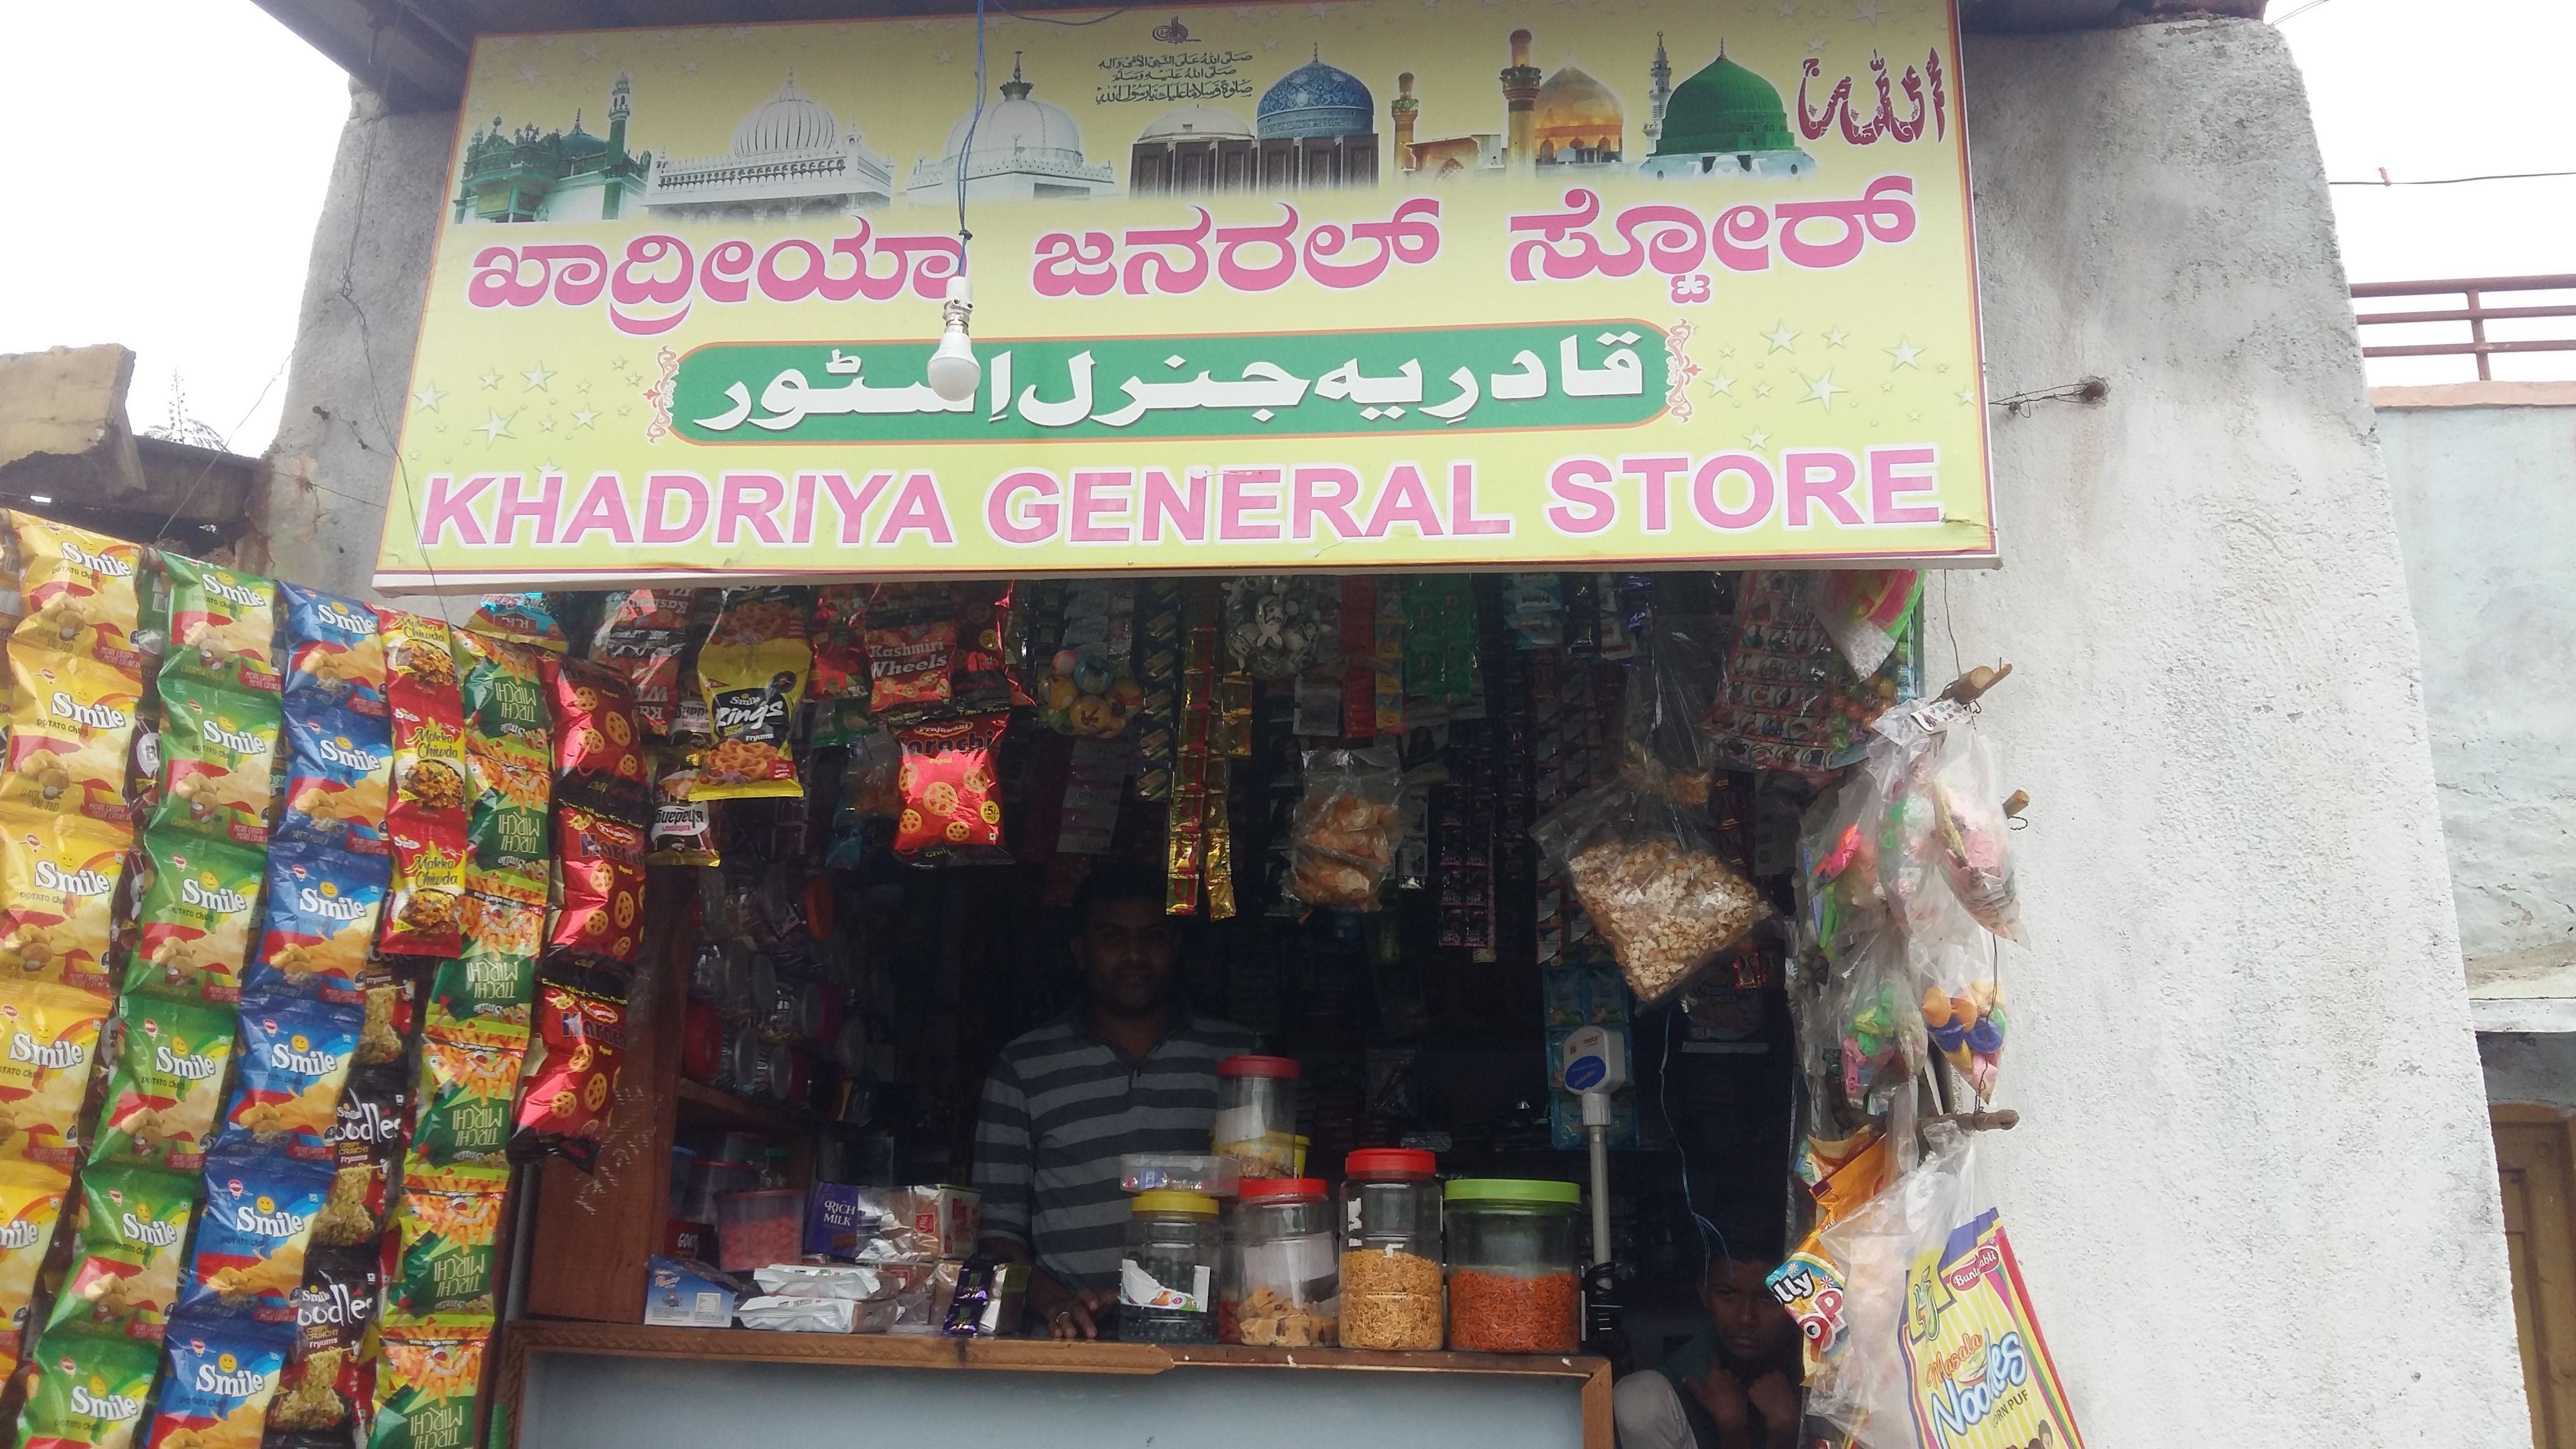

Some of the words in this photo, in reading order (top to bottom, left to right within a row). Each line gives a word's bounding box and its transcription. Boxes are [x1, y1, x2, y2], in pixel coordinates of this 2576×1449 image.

[1032, 198, 1441, 298] ಜನರಲ್
[421, 473, 955, 546] KHADRIYA
[985, 464, 1511, 545] GENERAL
[1547, 448, 1943, 534] STORE
[61, 540, 133, 577] Smile
[202, 573, 267, 607] Smile
[316, 603, 376, 635] Smile
[871, 637, 945, 658] Kashmiri
[871, 655, 948, 678] Wheels
[494, 681, 537, 707] MIRCHI
[52, 691, 126, 729] Smile
[500, 704, 537, 723] TIRCHI
[202, 718, 266, 755] Smile
[404, 728, 454, 744] Makka
[500, 723, 527, 738] Smile
[746, 733, 774, 742] Fryums
[320, 739, 382, 771] Smile
[417, 744, 459, 759] Chiwda
[498, 811, 540, 838] MIRCHI
[500, 834, 539, 854] TIRCHI
[404, 854, 454, 873] Makka
[35, 860, 110, 896] Smile
[414, 871, 458, 888] Chiwda
[182, 877, 247, 914] Smile
[299, 887, 367, 920] Smile
[466, 959, 519, 983] MIRCHI
[474, 981, 517, 999] TIRCHI
[9, 1032, 85, 1070] Smile
[155, 1045, 217, 1080] Smile
[271, 1042, 338, 1076] Smile
[0, 1066, 21, 1076] OTATO
[452, 1104, 502, 1131] MIRCHI
[454, 1130, 499, 1148] TIRCHI
[822, 1213, 852, 1228] MILK
[824, 1199, 856, 1216] RICH
[0, 1220, 39, 1249] mile
[122, 1212, 178, 1247] Smile
[236, 1205, 305, 1238] Smile
[434, 1253, 485, 1281] MIRCHI
[301, 1289, 331, 1303] Smile
[437, 1276, 480, 1299] TIRCHI
[1773, 1271, 1815, 1304] lly
[309, 1337, 339, 1349] Fryums
[1926, 1332, 1983, 1390] Masala
[195, 1364, 266, 1398] Smile
[70, 1383, 139, 1422] Smile
[410, 1405, 464, 1433] MIRCHI
[415, 1428, 460, 1449] TIRCHI
